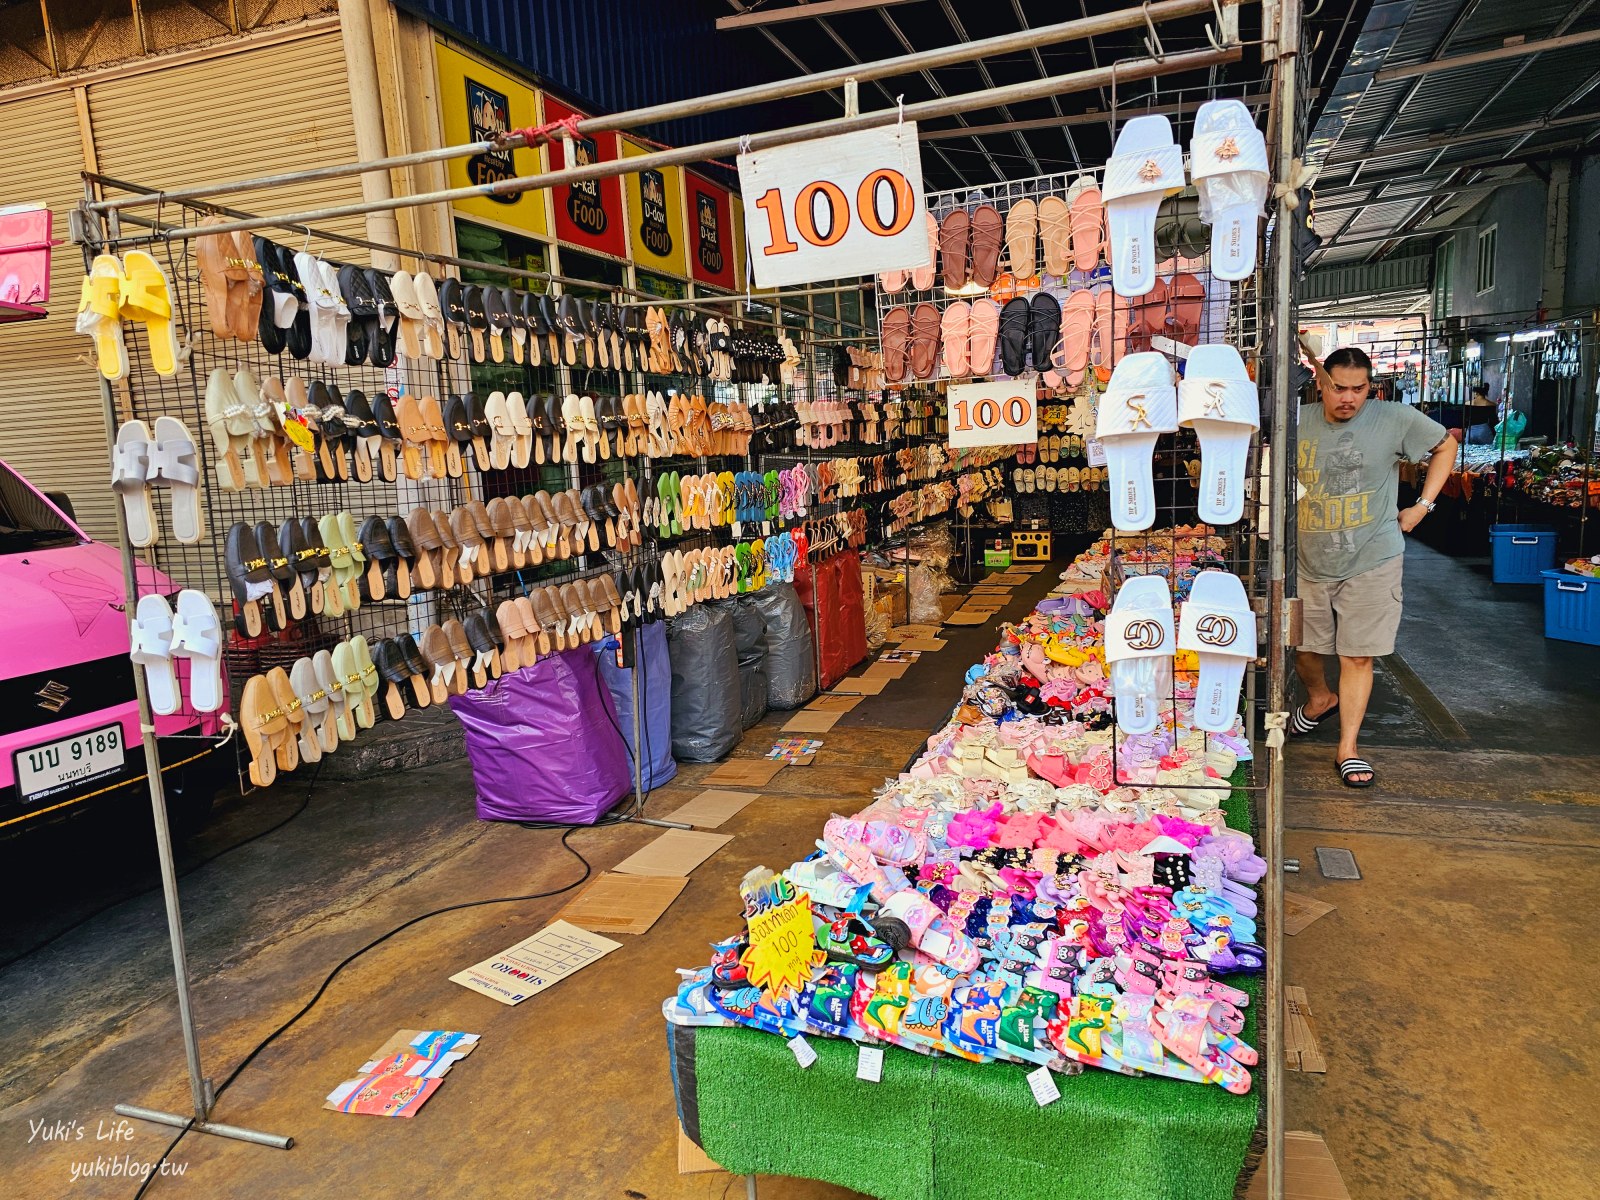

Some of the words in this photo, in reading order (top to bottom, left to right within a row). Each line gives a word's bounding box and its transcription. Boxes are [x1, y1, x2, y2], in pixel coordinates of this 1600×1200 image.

[573, 199, 604, 231] FOOD
[644, 202, 665, 225] D-dox
[756, 168, 914, 256] 100
[645, 226, 669, 253] FOOD
[700, 226, 717, 244] D-kat
[702, 247, 722, 270] FOOD
[953, 396, 1032, 431] 100
[1298, 439, 1319, 469] Si
[71, 731, 118, 761] 9189
[57, 762, 92, 782] นนทบุรี
[744, 877, 797, 918] SALE
